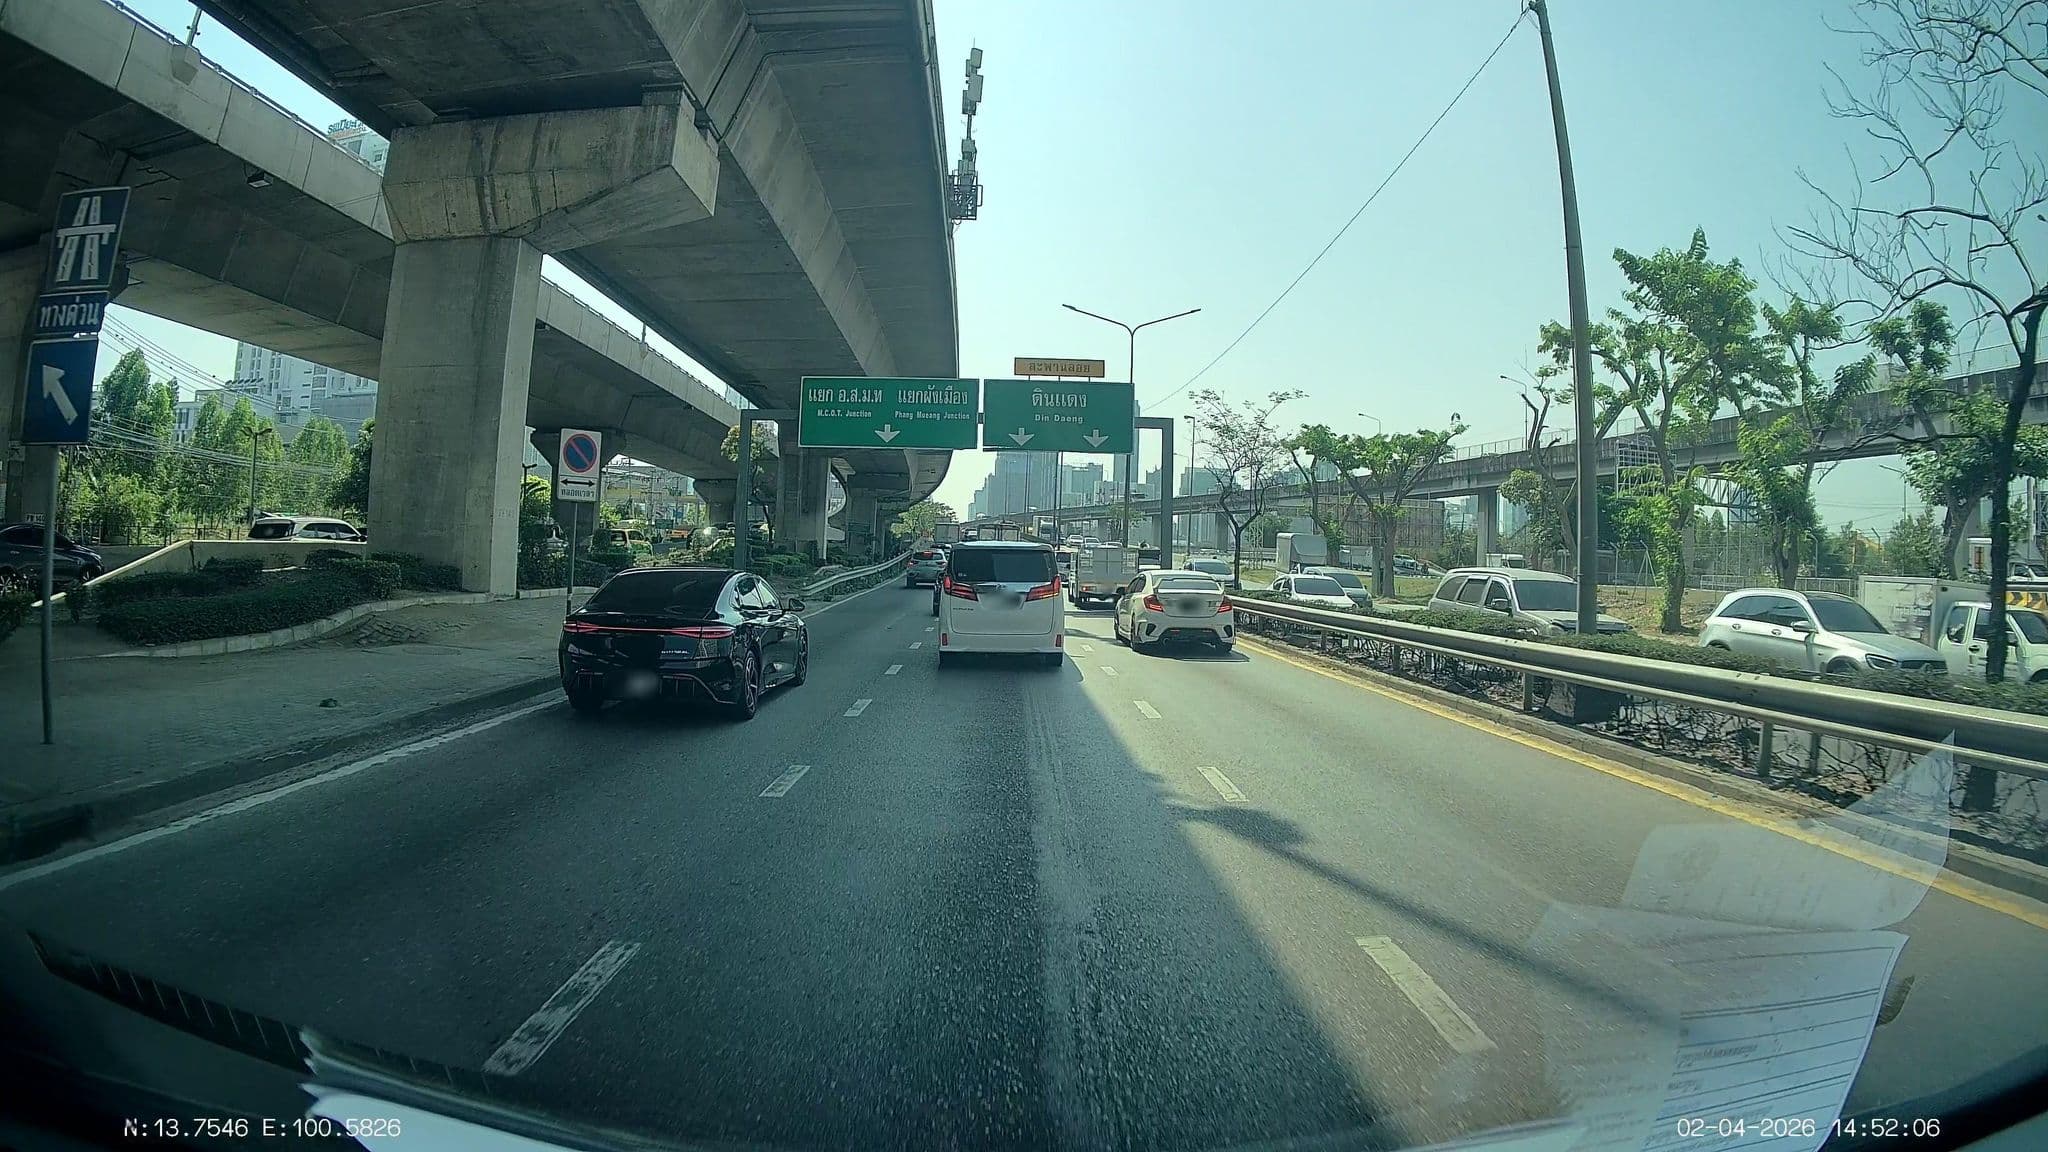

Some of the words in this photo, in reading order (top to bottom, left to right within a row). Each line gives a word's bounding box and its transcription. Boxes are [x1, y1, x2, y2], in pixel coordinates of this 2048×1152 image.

[40, 296, 100, 328] ทางด่วน
[808, 388, 833, 402] แยก
[898, 384, 968, 404] แยกผังเมือง
[1032, 387, 1087, 407] ดินแดง
[817, 409, 843, 417] M.C.O.T.
[845, 409, 872, 418] Junction
[894, 410, 914, 420] Phang
[916, 411, 941, 421] Mueang
[943, 411, 970, 420] Junction
[1054, 414, 1083, 424] Daeng
